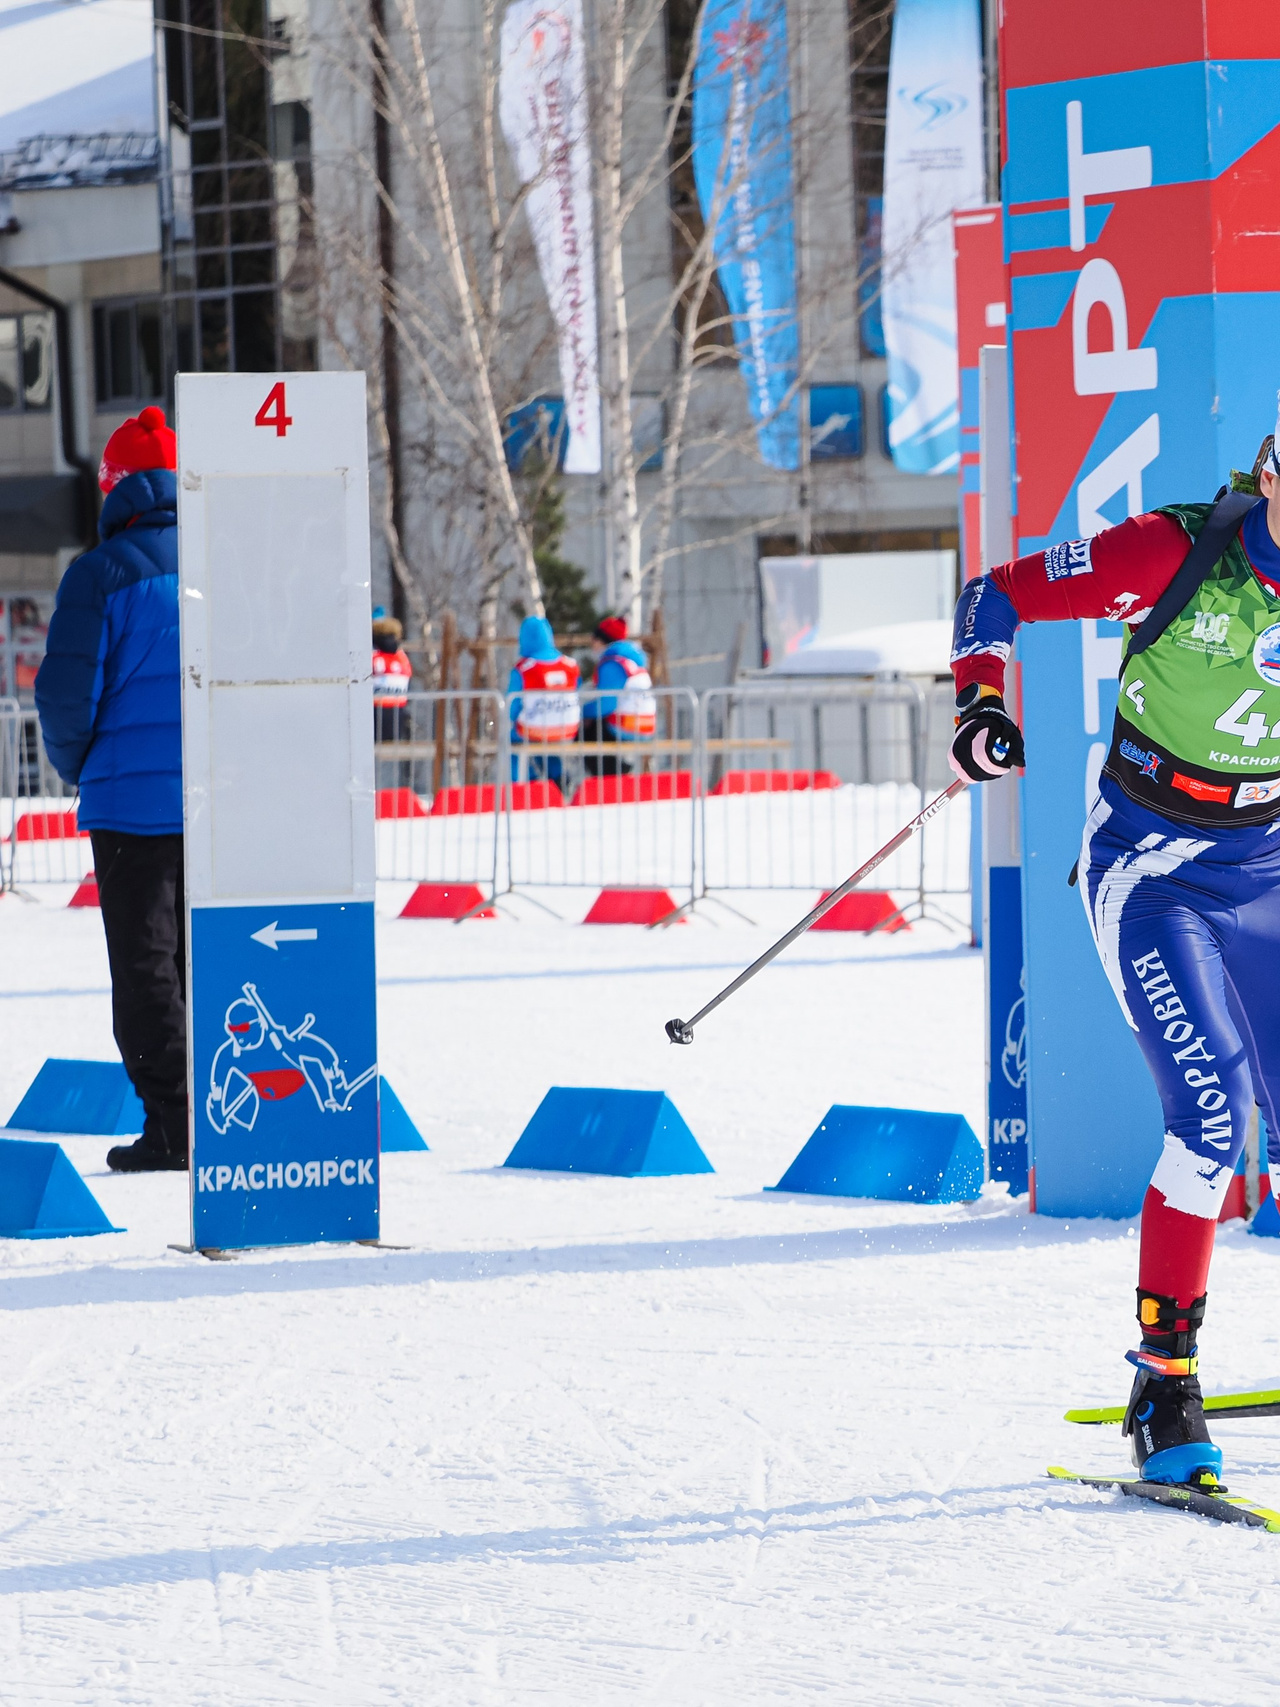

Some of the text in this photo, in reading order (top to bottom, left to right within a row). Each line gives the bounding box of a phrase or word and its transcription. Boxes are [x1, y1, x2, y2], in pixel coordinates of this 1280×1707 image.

[254, 381, 293, 437] 4
[1189, 780, 1228, 793] КРАСНОЯРСКИЙ
[1131, 947, 1232, 1151] МОРДОВИЯ
[993, 1118, 1028, 1145] КР
[198, 1158, 375, 1193] КРАСНОЯРСК
[1136, 1357, 1167, 1370] SALOMON
[1141, 1424, 1155, 1454] SALOMON
[1168, 1488, 1191, 1501] FISCHER
